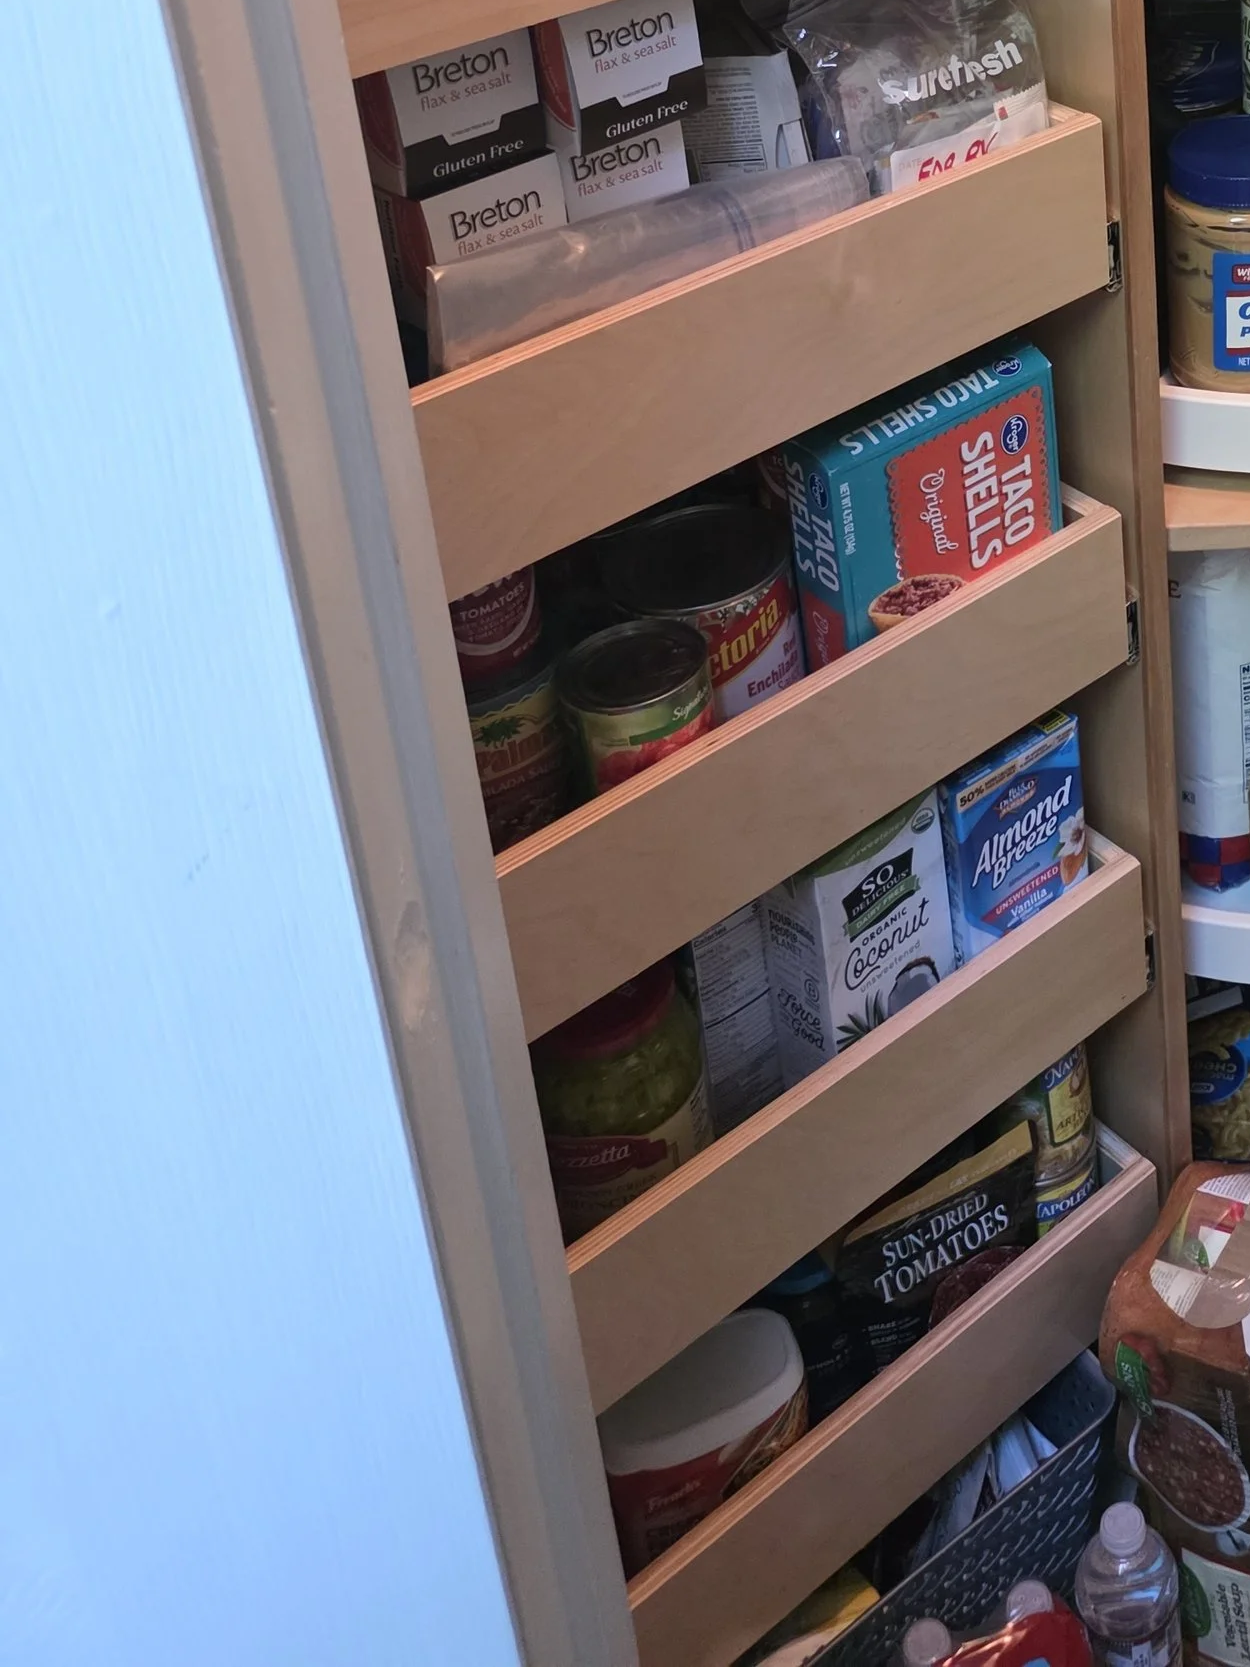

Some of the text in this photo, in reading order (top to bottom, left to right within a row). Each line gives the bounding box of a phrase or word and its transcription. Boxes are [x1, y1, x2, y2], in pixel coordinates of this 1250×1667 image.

[585, 9, 674, 59] Breton
[594, 35, 677, 75] flax & sea salt
[411, 45, 509, 96] Breton
[605, 98, 689, 140] Gluten Free
[432, 137, 525, 178] Gluten Free
[570, 135, 662, 184] Breton
[449, 189, 542, 241] Breton
[838, 367, 1001, 456] TACO SHELLS
[1003, 417, 1024, 453] Kroger
[920, 468, 959, 555] Original
[960, 431, 1003, 571] SHELLS
[1001, 454, 1035, 547] TACO
[811, 514, 840, 593] TACO
[459, 582, 526, 621] TOMATOES
[747, 650, 800, 700] Enchilada
[959, 784, 986, 808] 50%
[971, 774, 1073, 888] Almond
[992, 817, 1057, 891] Breeze
[851, 867, 910, 918] DELICIOUS
[861, 863, 895, 900] SO
[995, 866, 1059, 915] UNSWEETENED
[1010, 887, 1048, 919] Vanilla
[855, 884, 907, 930] DAIRY FREE
[862, 907, 908, 946] ORGANIC
[845, 896, 930, 992] Coconut
[874, 1203, 1010, 1305] TOMATOES
[881, 1192, 989, 1268] SUN-DRIED
[1224, 1584, 1237, 1647] Vegetable
[1234, 1581, 1246, 1611] Soup
